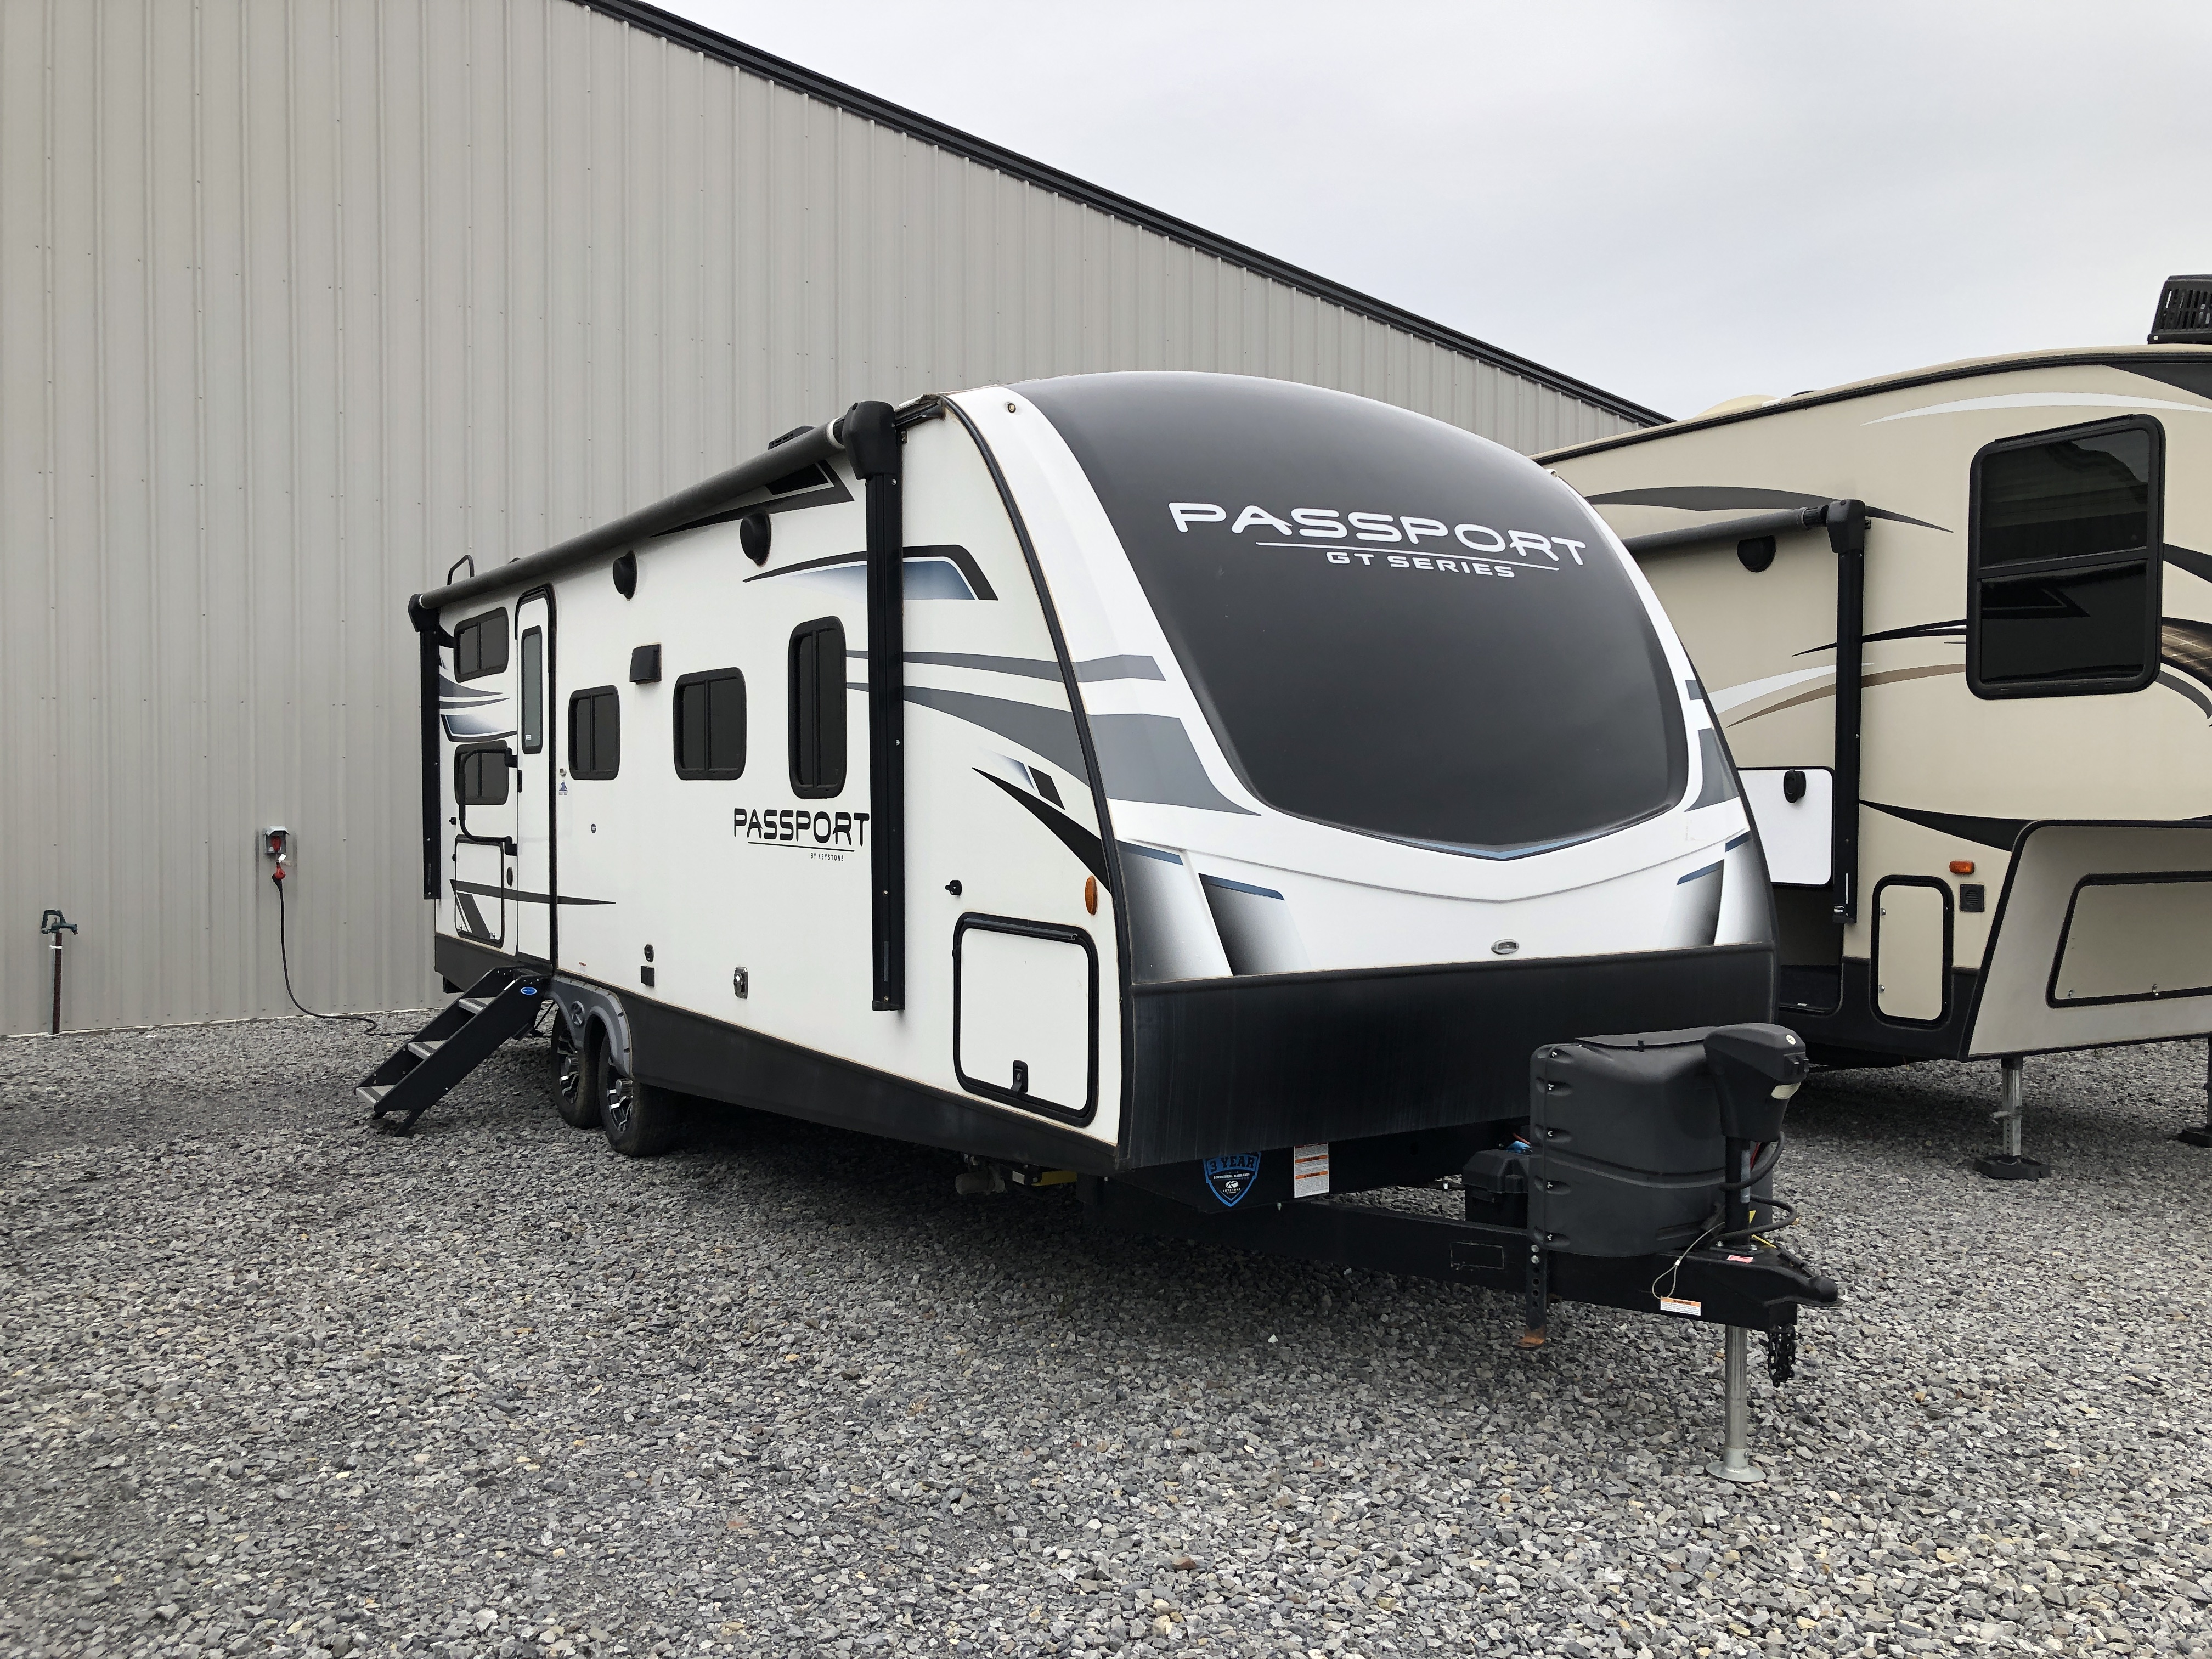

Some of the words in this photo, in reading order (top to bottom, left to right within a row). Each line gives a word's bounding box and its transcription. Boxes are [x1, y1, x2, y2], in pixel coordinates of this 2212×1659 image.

[1168, 502, 1586, 566] PASSPORT
[1327, 551, 1374, 566] GT
[1387, 555, 1515, 578] SERIES
[733, 808, 870, 847] PASSPORT
[818, 853, 844, 862] KEYSTONE
[1210, 1160, 1217, 1172] 3
[1221, 1156, 1254, 1168] YEAR
